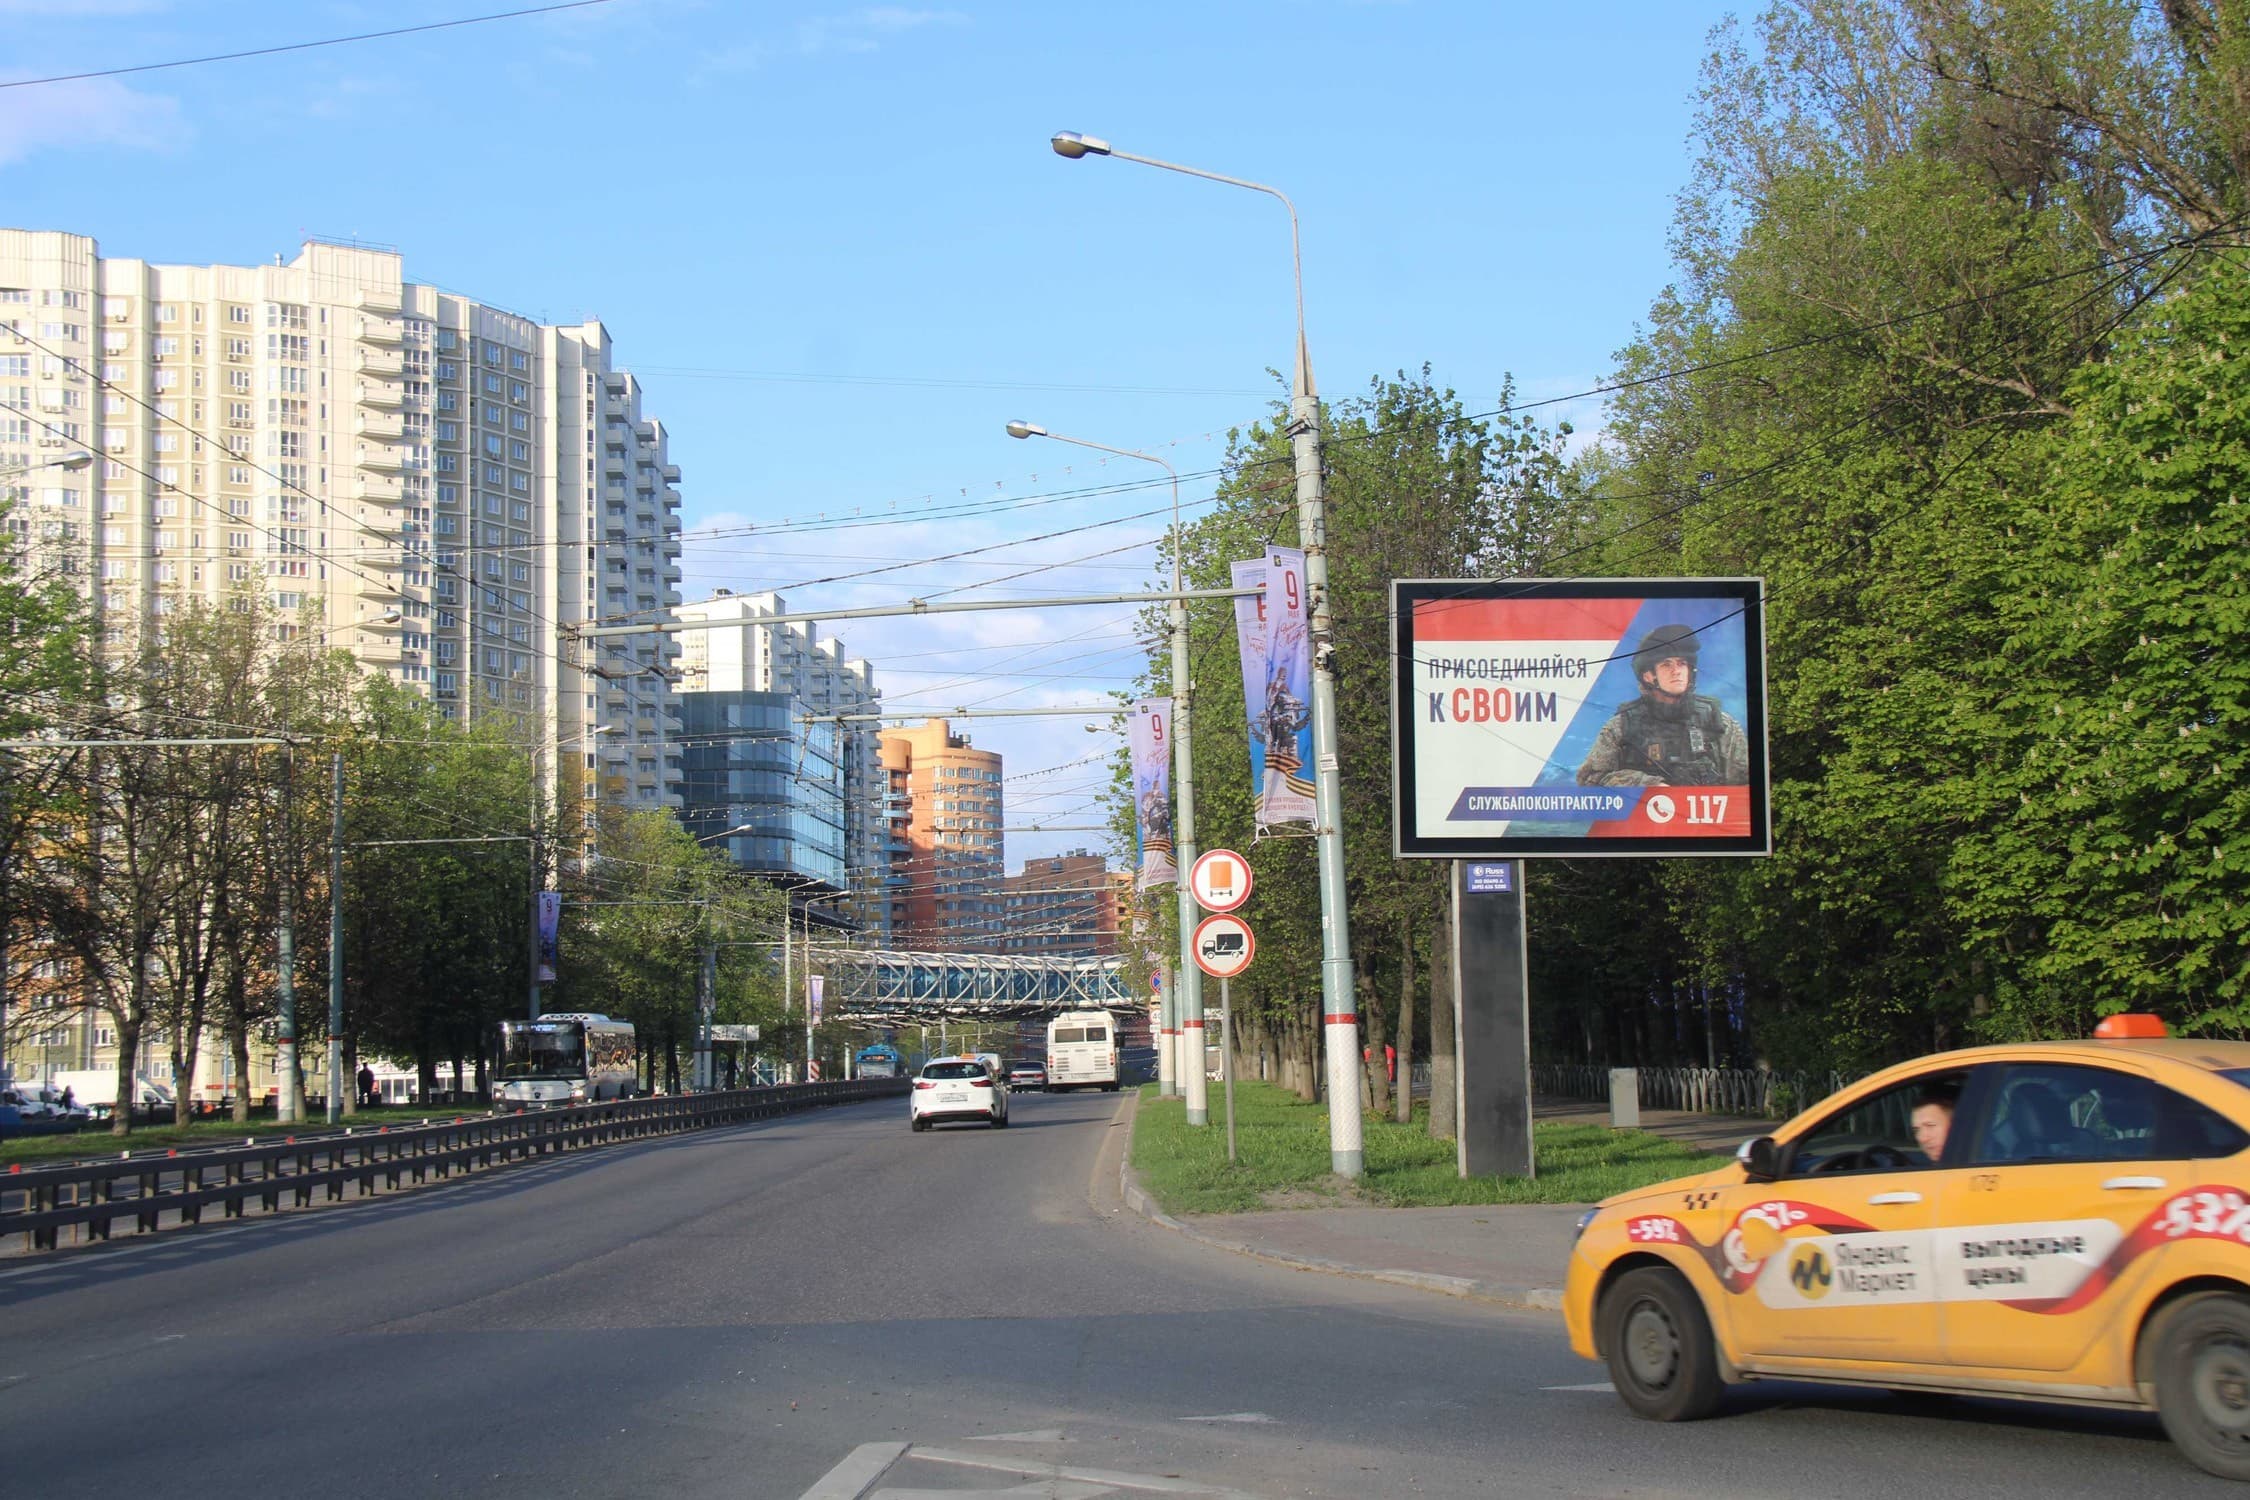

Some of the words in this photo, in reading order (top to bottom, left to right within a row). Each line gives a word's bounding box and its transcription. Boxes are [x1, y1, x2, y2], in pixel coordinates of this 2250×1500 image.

[1285, 570, 1299, 610] 9
[1429, 654, 1587, 681] ПРИСОЕДИНЯЙСЯ
[1429, 692, 1446, 723] К
[1151, 713, 1164, 741] 9
[1468, 795, 1624, 812] СЛУЖБАПОКОНТРАКТУ.РФ
[1686, 794, 1729, 824] 117
[1629, 1218, 1680, 1242] -59%
[1835, 1242, 1911, 1268] Яндекс
[1960, 1236, 2086, 1260] выгодные
[1837, 1268, 1917, 1296] Маркет
[1963, 1266, 2028, 1290] цены
